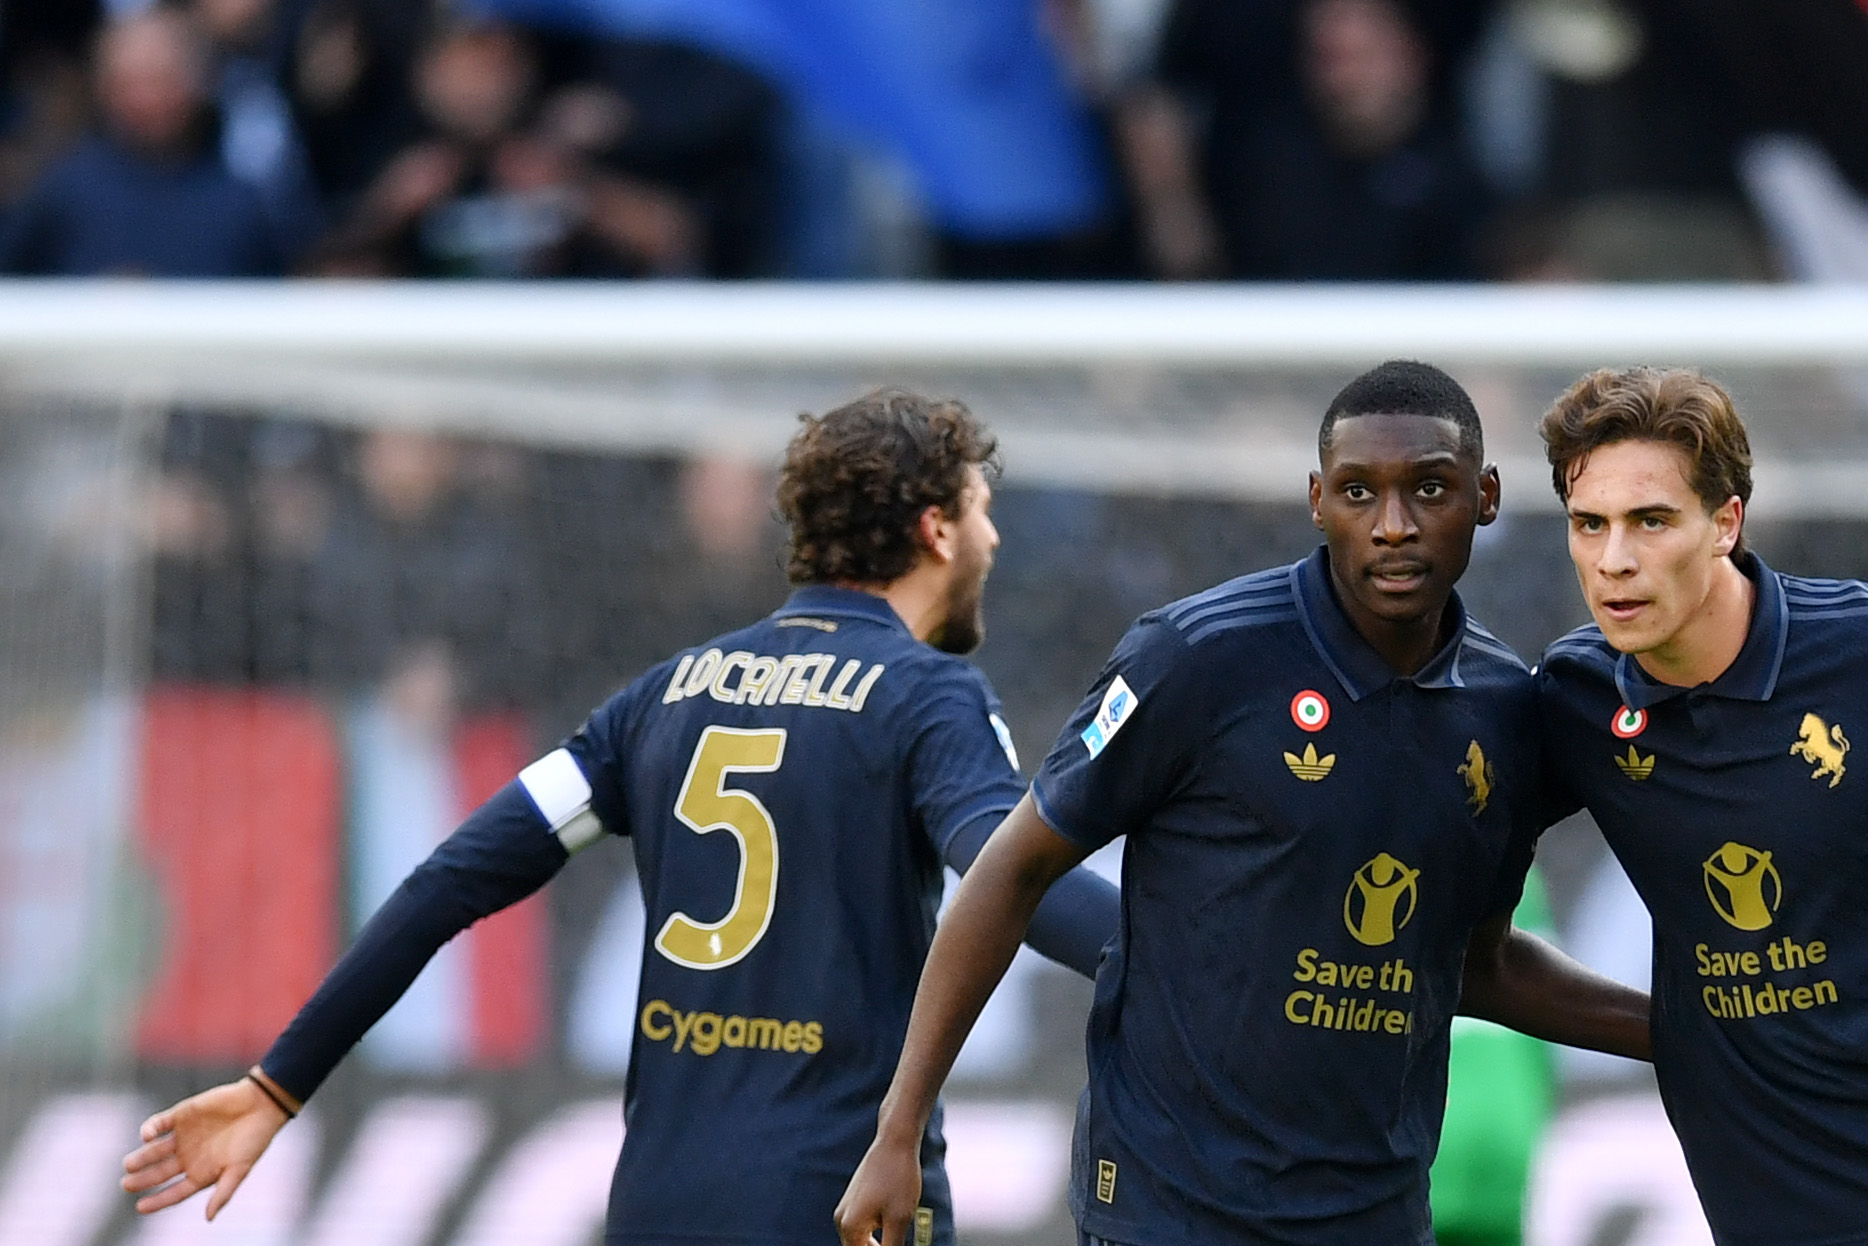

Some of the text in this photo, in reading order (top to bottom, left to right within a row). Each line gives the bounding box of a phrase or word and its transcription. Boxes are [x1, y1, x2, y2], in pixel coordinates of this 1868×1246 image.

[662, 648, 885, 712] LOCATELLI
[654, 725, 787, 970] 5
[1293, 948, 1414, 993] Save th
[1695, 936, 1828, 977] Save the
[1702, 979, 1839, 1019] Children
[640, 999, 824, 1056] Cygames
